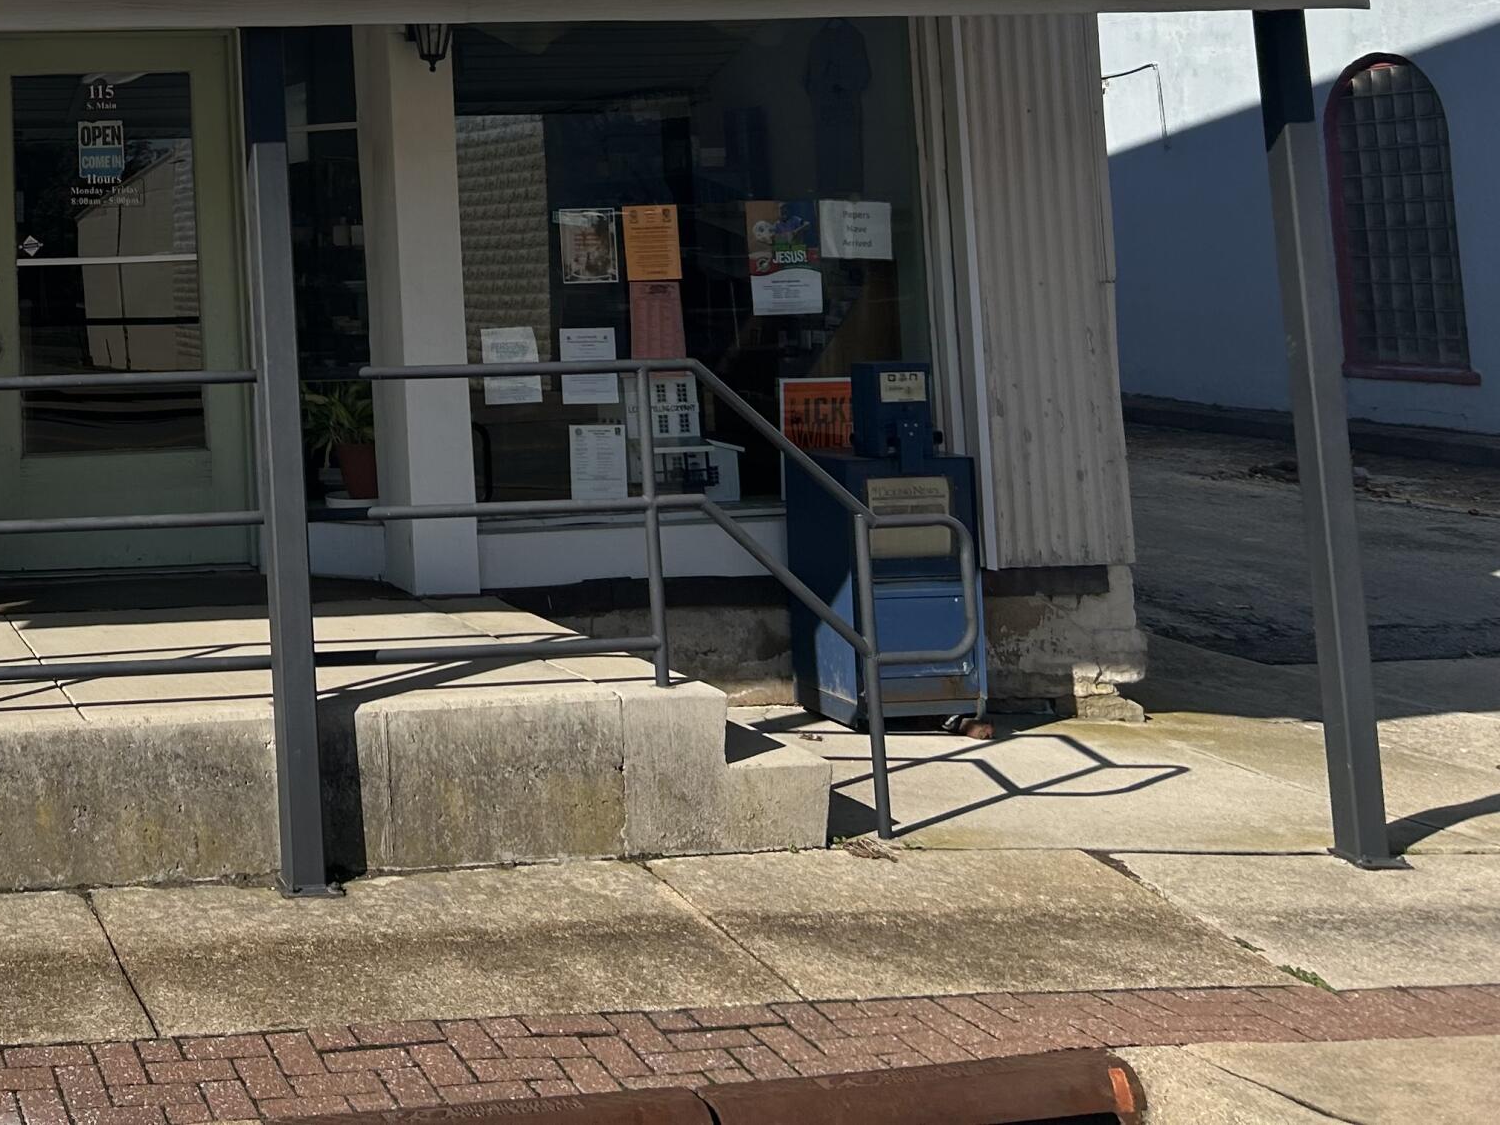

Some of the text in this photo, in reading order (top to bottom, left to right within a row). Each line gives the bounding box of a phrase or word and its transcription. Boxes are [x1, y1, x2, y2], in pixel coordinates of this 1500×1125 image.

[89, 84, 115, 99] 115
[86, 102, 117, 110] S. Main
[80, 125, 122, 146] OPEN
[82, 155, 122, 169] COME IN
[86, 174, 122, 185] Hours
[70, 187, 103, 196] Monday
[772, 250, 808, 264] JESUS!
